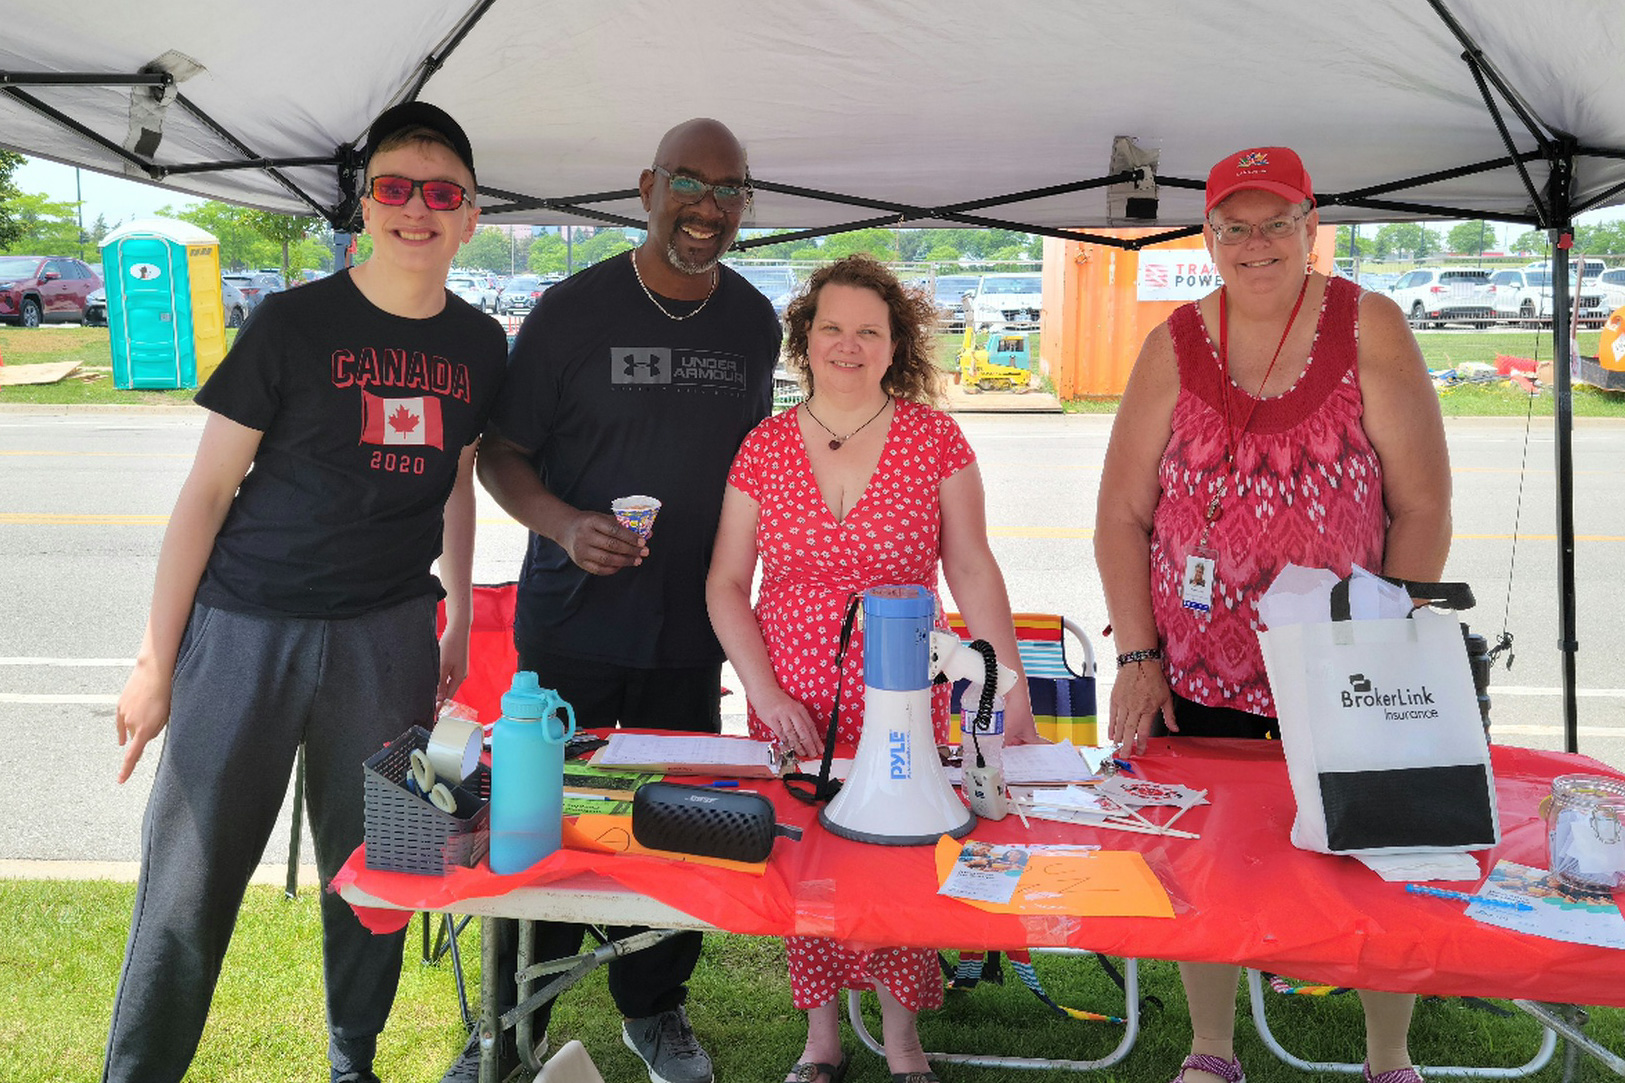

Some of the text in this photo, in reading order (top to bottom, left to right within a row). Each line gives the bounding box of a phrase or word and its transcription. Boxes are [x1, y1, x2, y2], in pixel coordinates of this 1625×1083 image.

[1175, 275, 1222, 287] POWE
[681, 356, 737, 371] UNDER
[331, 346, 470, 404] CANADA
[673, 367, 744, 385] ARMOUR
[370, 450, 425, 475] 2020
[1341, 686, 1435, 708] BrokerLink
[1384, 708, 1439, 721] Insurance
[889, 731, 906, 779] PYLE
